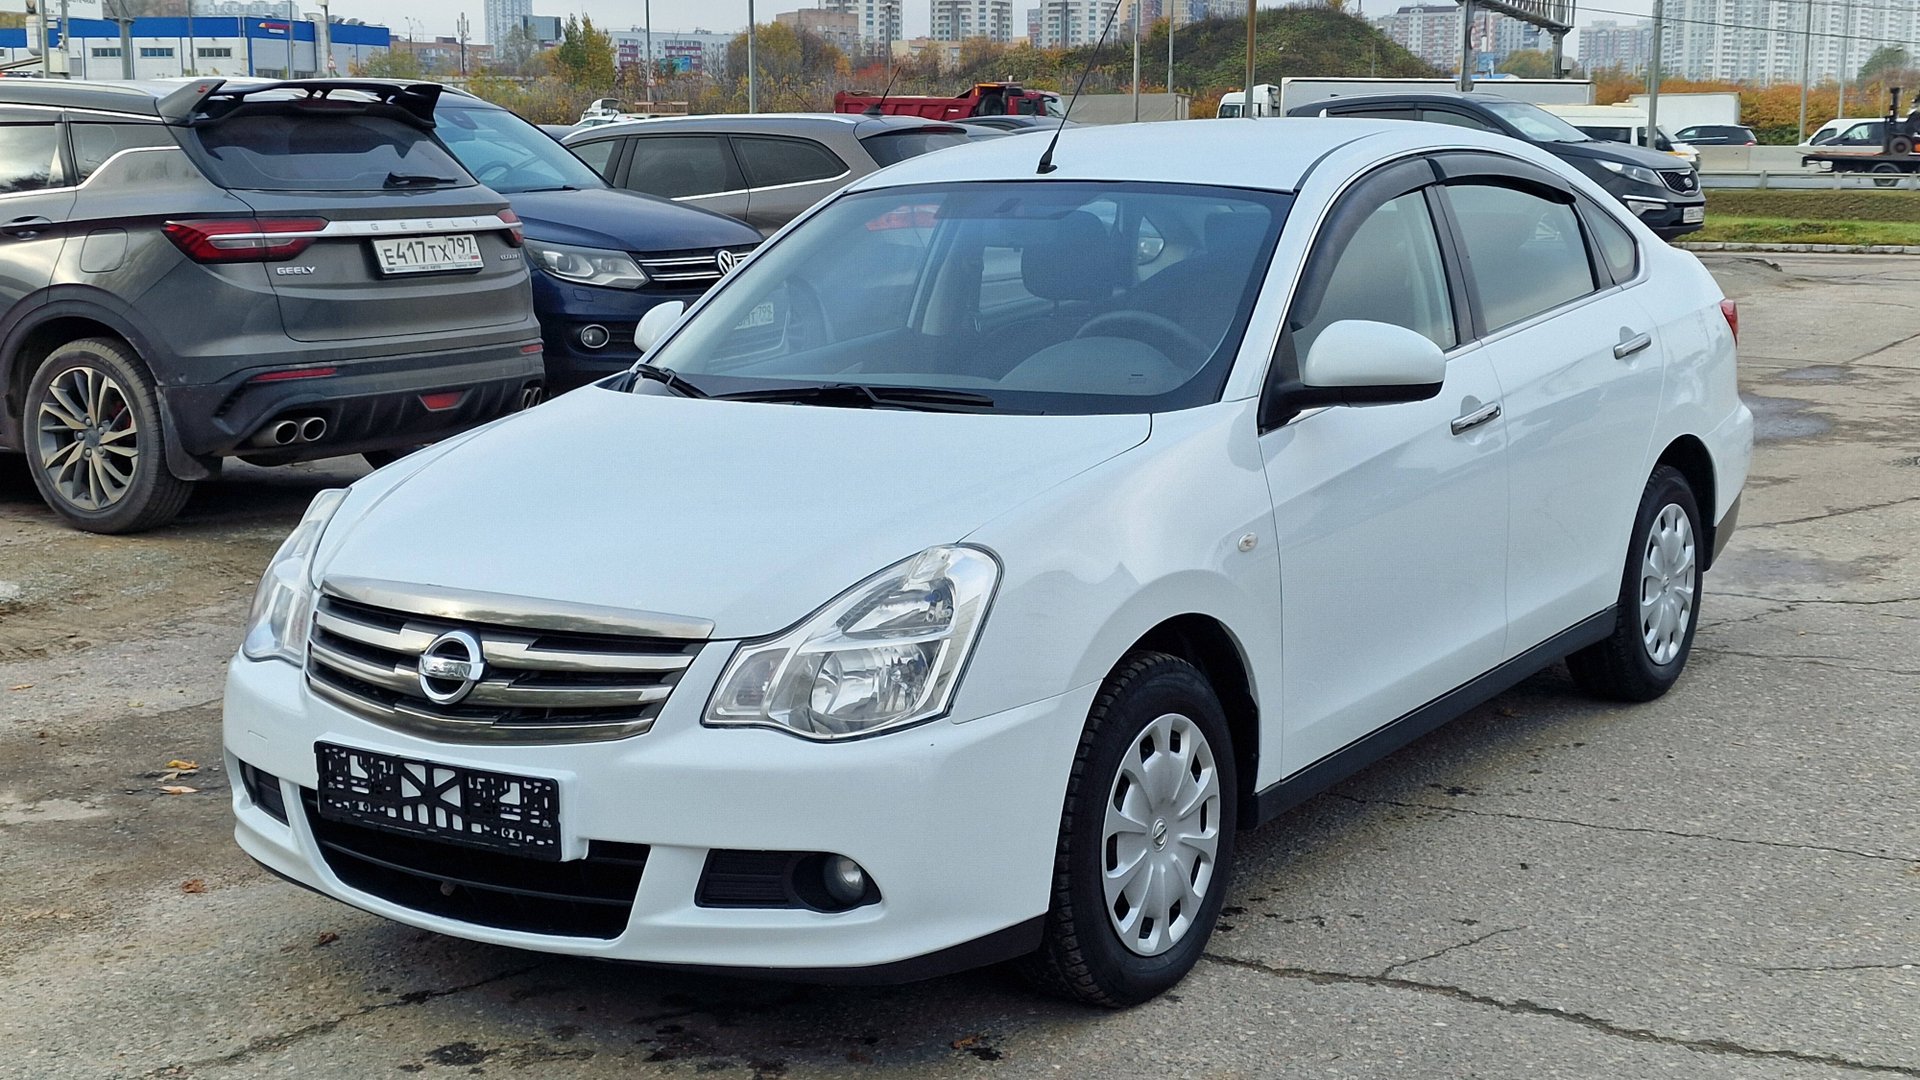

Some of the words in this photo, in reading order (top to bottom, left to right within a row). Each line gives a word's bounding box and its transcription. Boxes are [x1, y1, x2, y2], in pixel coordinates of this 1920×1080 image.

[370, 218, 480, 231] GEELY
[448, 236, 473, 254] 797
[276, 266, 316, 275] GEELY
